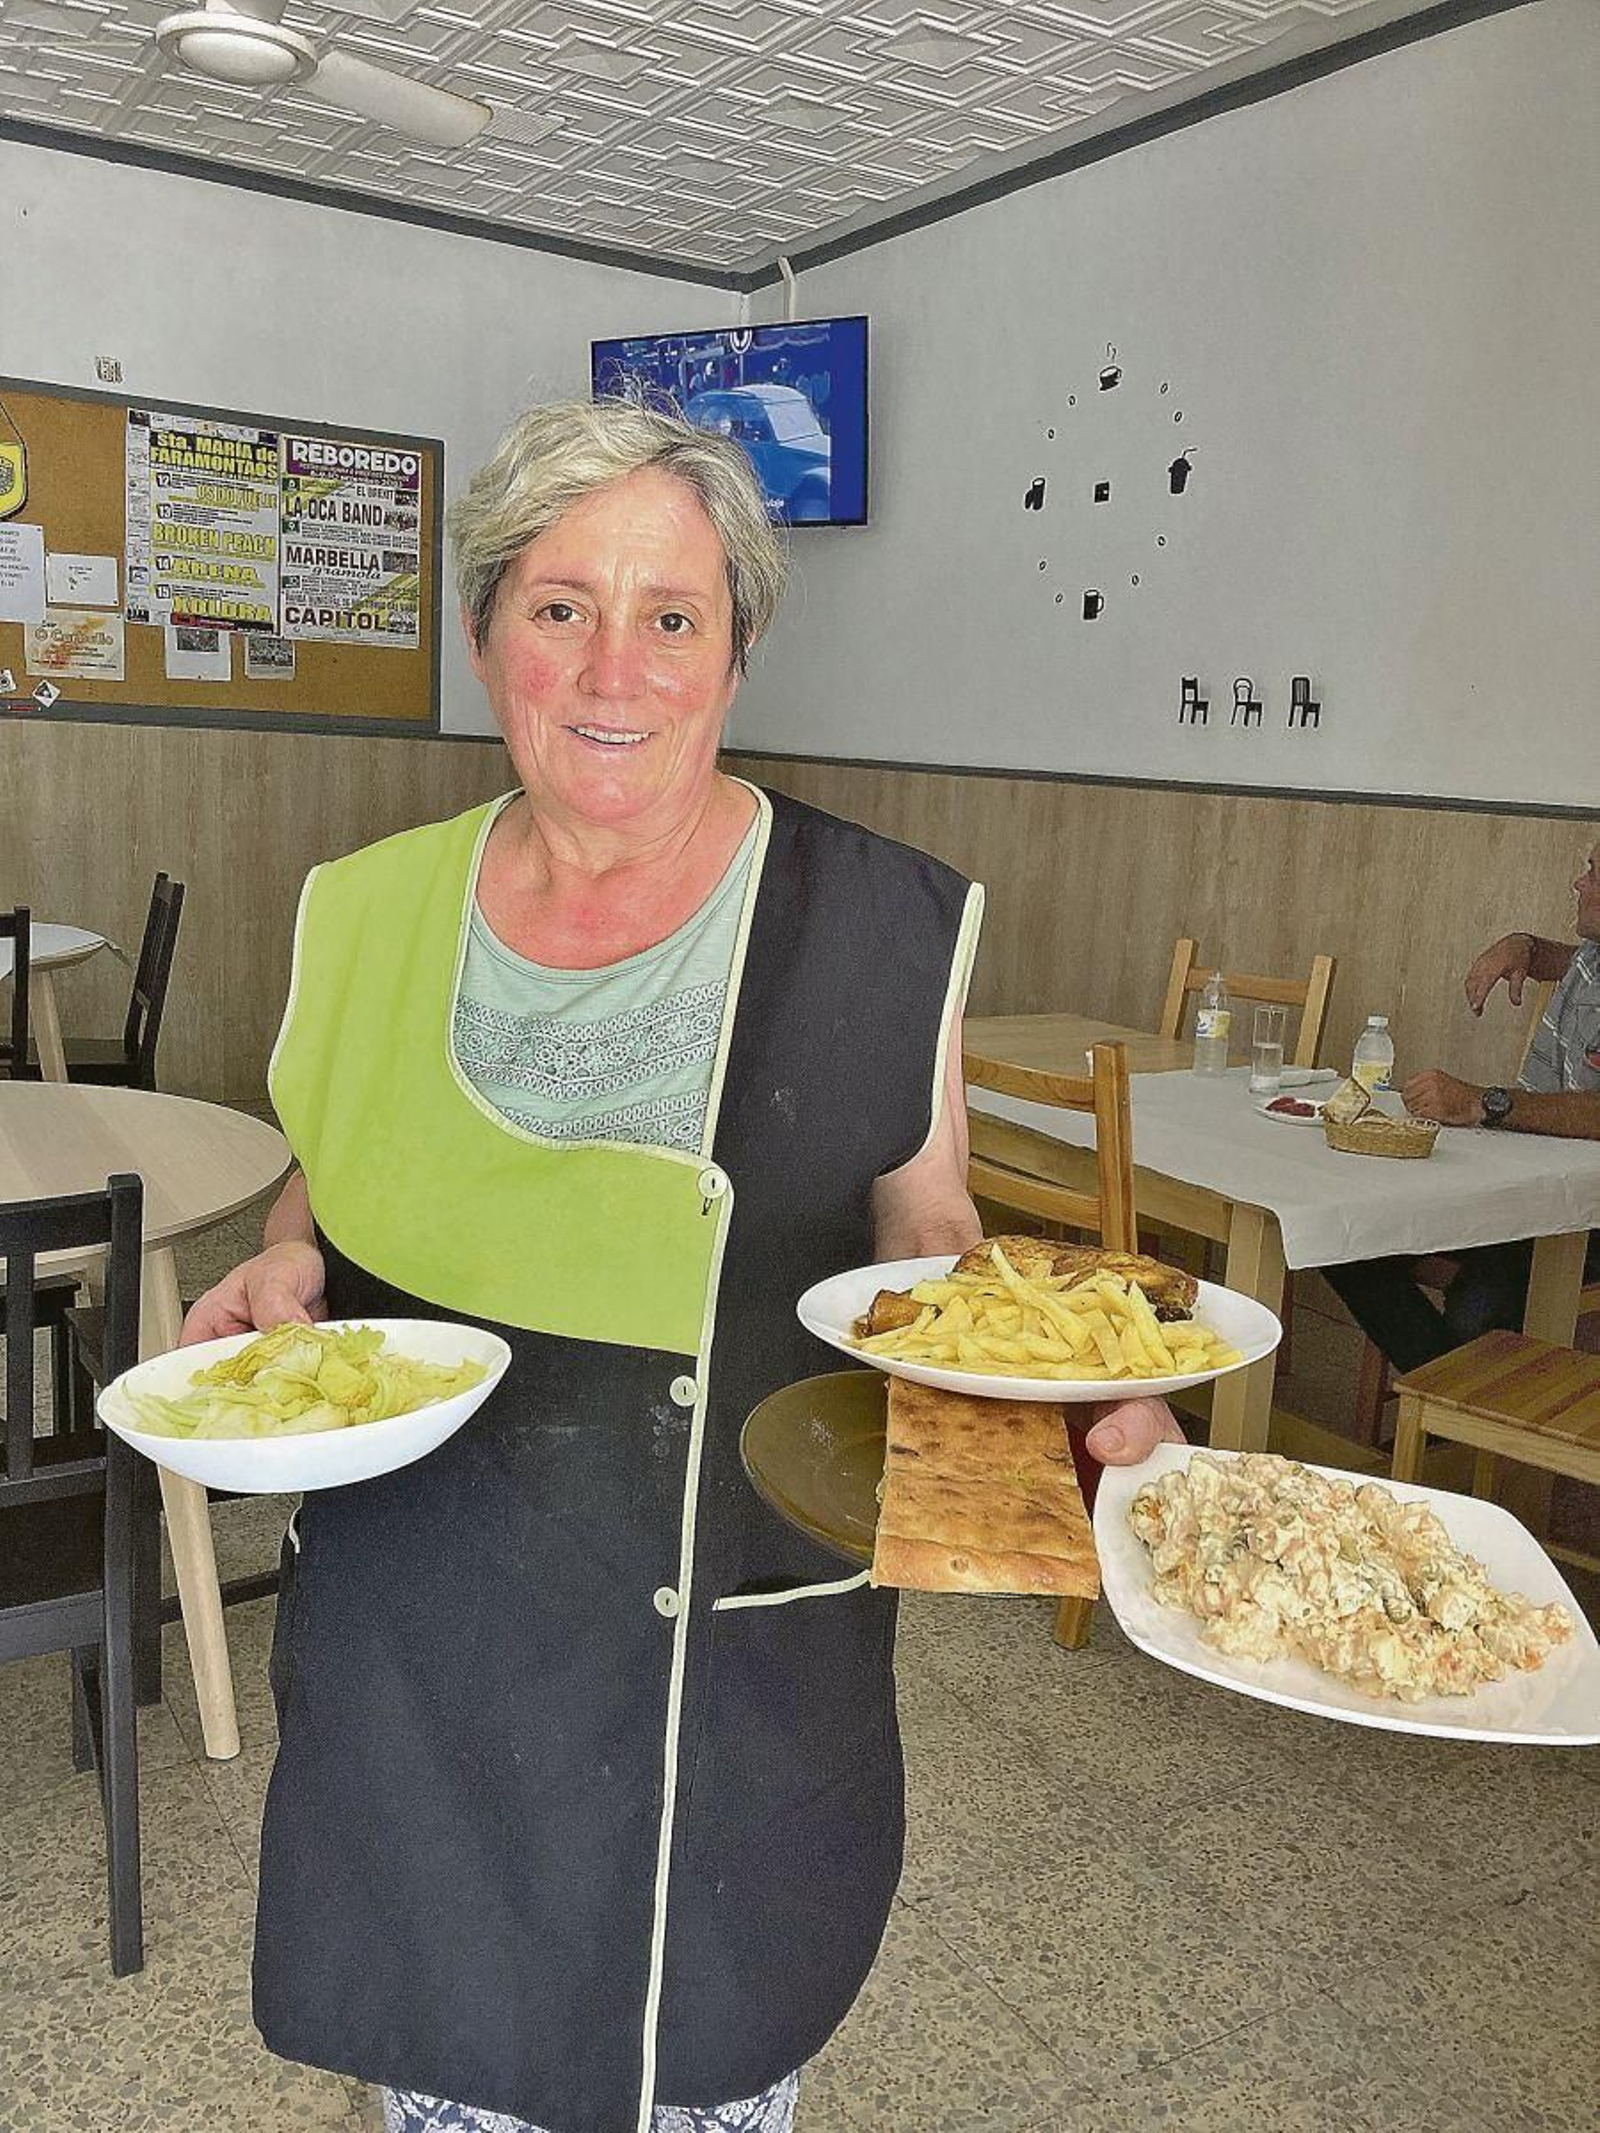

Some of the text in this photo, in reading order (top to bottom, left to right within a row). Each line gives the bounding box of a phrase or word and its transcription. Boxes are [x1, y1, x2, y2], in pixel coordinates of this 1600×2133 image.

[150, 447, 278, 478] FARAMONTAOS
[255, 447, 278, 463] de
[292, 441, 417, 476] REBOREDO
[285, 496, 302, 517] LA
[308, 498, 337, 521] OCA
[342, 501, 383, 526] BAND
[153, 522, 220, 549] BROKEN
[222, 531, 276, 557] PEACH
[285, 546, 381, 572] MARBELLA
[285, 607, 386, 631] CAPITOL
